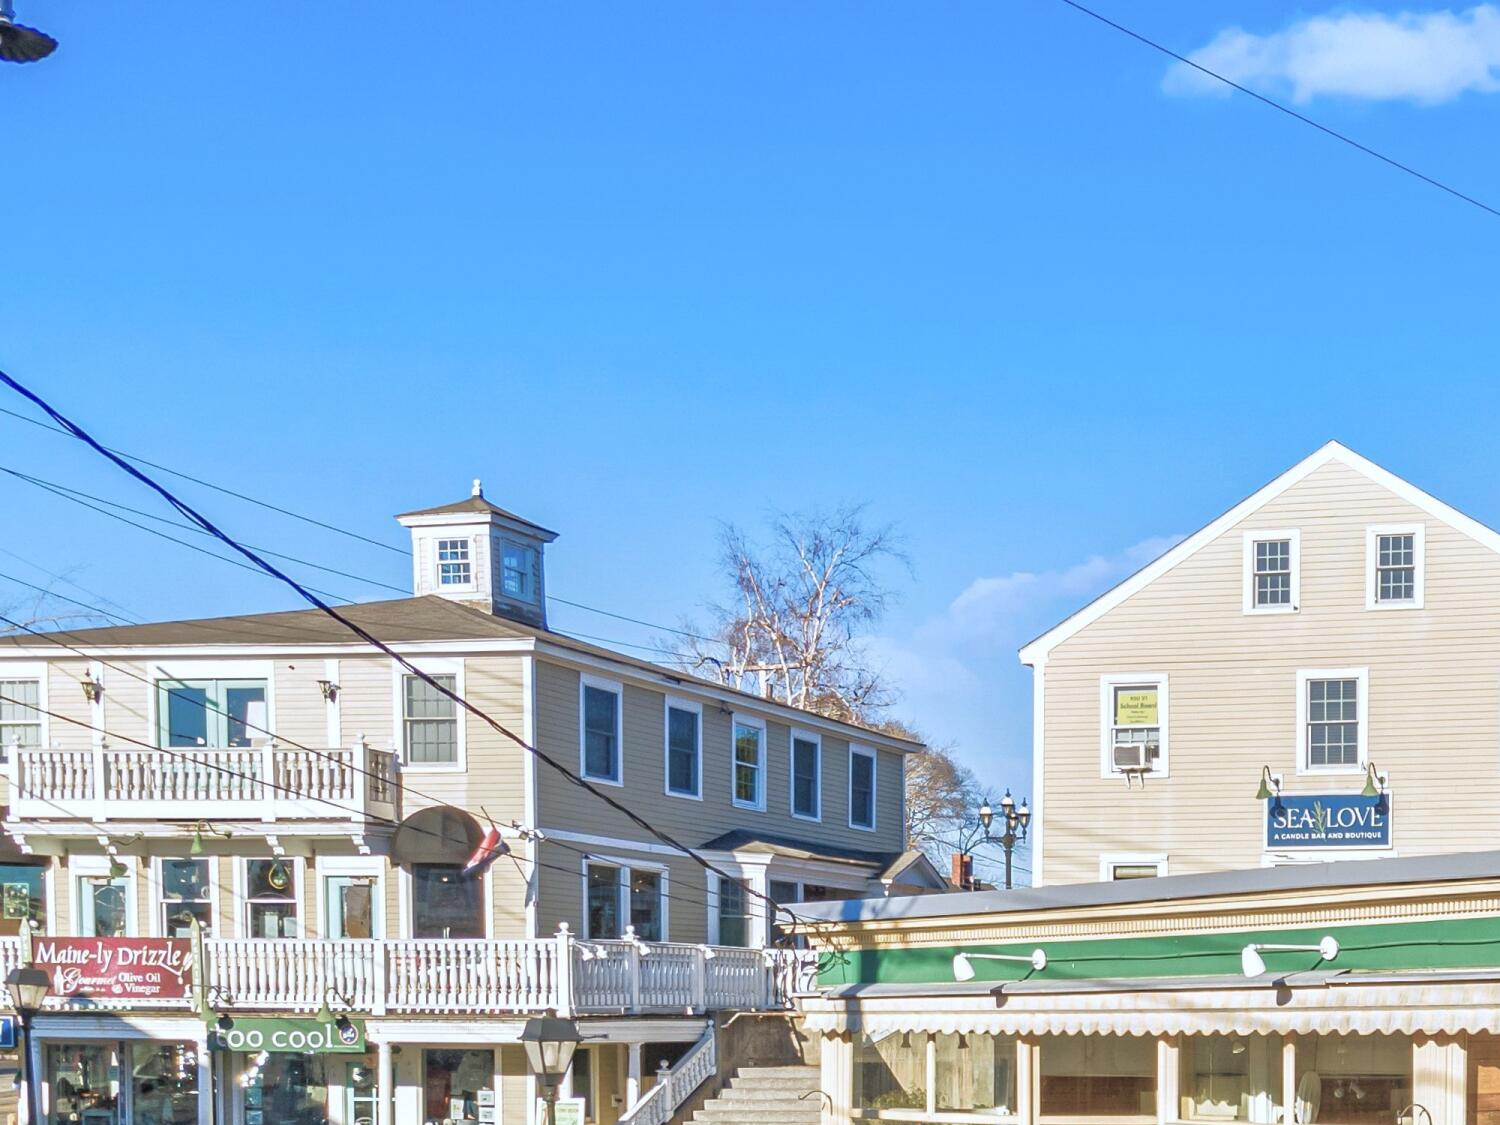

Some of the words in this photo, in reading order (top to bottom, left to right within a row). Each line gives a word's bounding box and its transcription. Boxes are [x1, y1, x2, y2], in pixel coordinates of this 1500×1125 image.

[1273, 807, 1315, 828] SEA
[1326, 806, 1383, 828] LOVE
[35, 941, 113, 973] Maine-ly
[117, 941, 182, 976] Drizzle
[62, 967, 117, 993] Gourmet
[118, 972, 143, 983] Olive
[146, 972, 161, 983] Oil
[125, 983, 160, 995] Vinegar
[210, 1023, 264, 1048] too
[272, 1023, 334, 1049] cool
